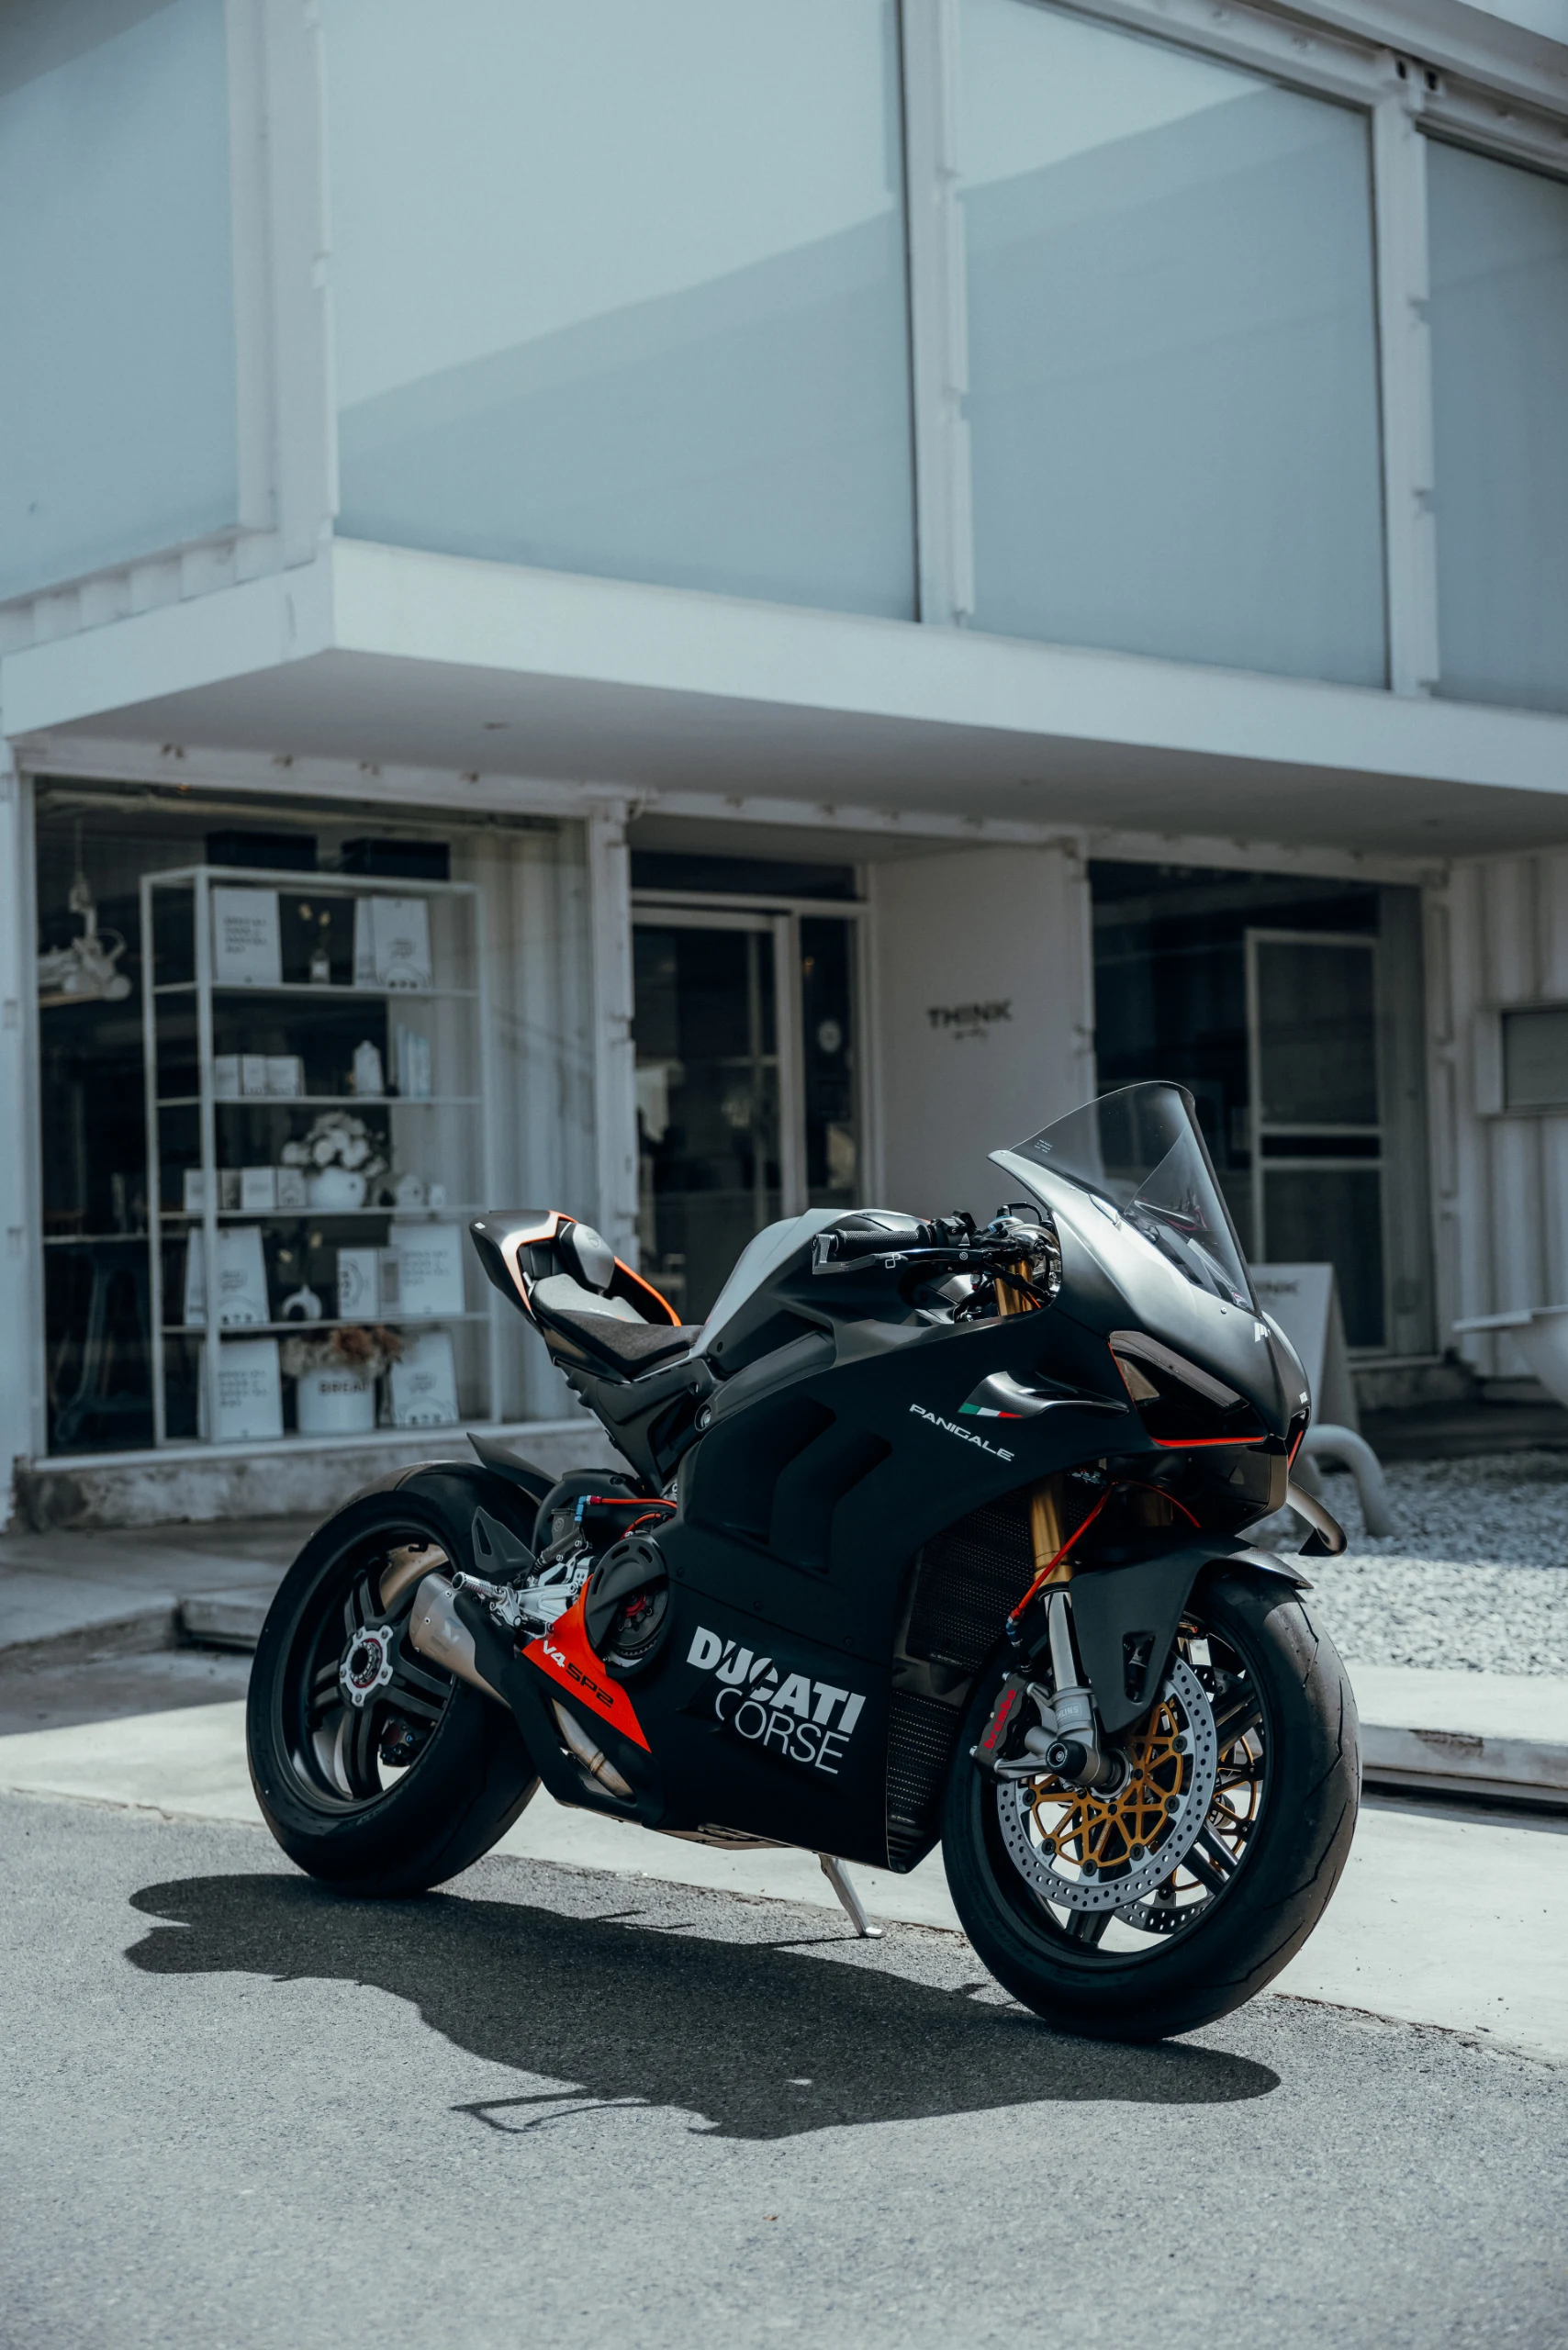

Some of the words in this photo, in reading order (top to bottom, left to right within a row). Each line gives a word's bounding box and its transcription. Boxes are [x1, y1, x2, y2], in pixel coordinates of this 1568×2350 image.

[927, 999, 1013, 1029] THINK
[910, 1404, 1015, 1462] PANIGALE
[543, 1639, 566, 1668] V4
[566, 1662, 614, 1708] SP2
[687, 1626, 867, 1735] DUCATI
[715, 1687, 850, 1774] CORSE
[983, 1690, 1016, 1749] brembo
